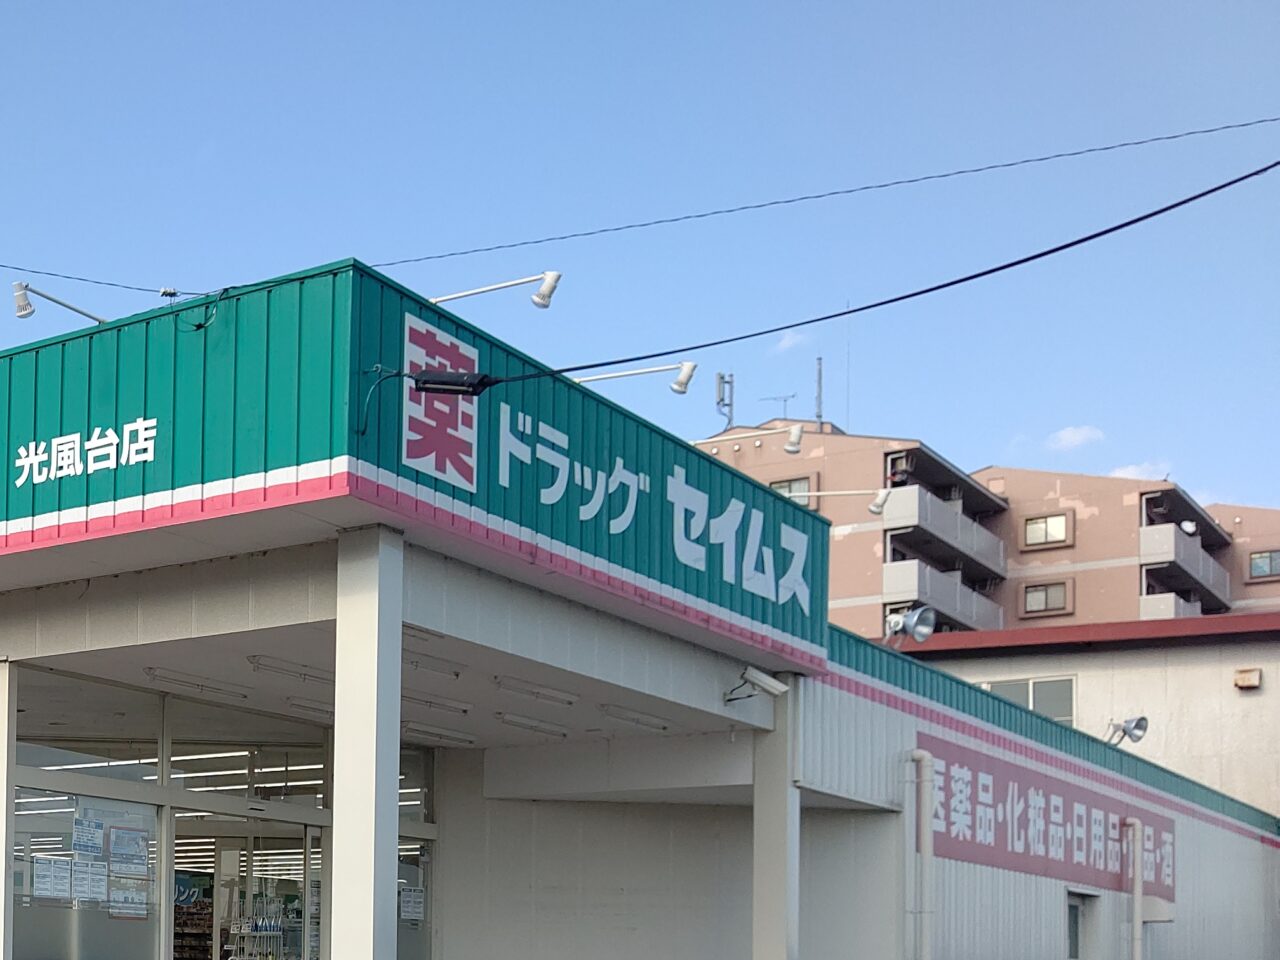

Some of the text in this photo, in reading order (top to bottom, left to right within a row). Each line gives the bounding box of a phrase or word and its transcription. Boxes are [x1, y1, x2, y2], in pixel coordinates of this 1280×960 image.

[14, 417, 158, 488] 光風台店
[407, 324, 476, 493] 薬
[499, 402, 810, 617] ドラッグ セイムス
